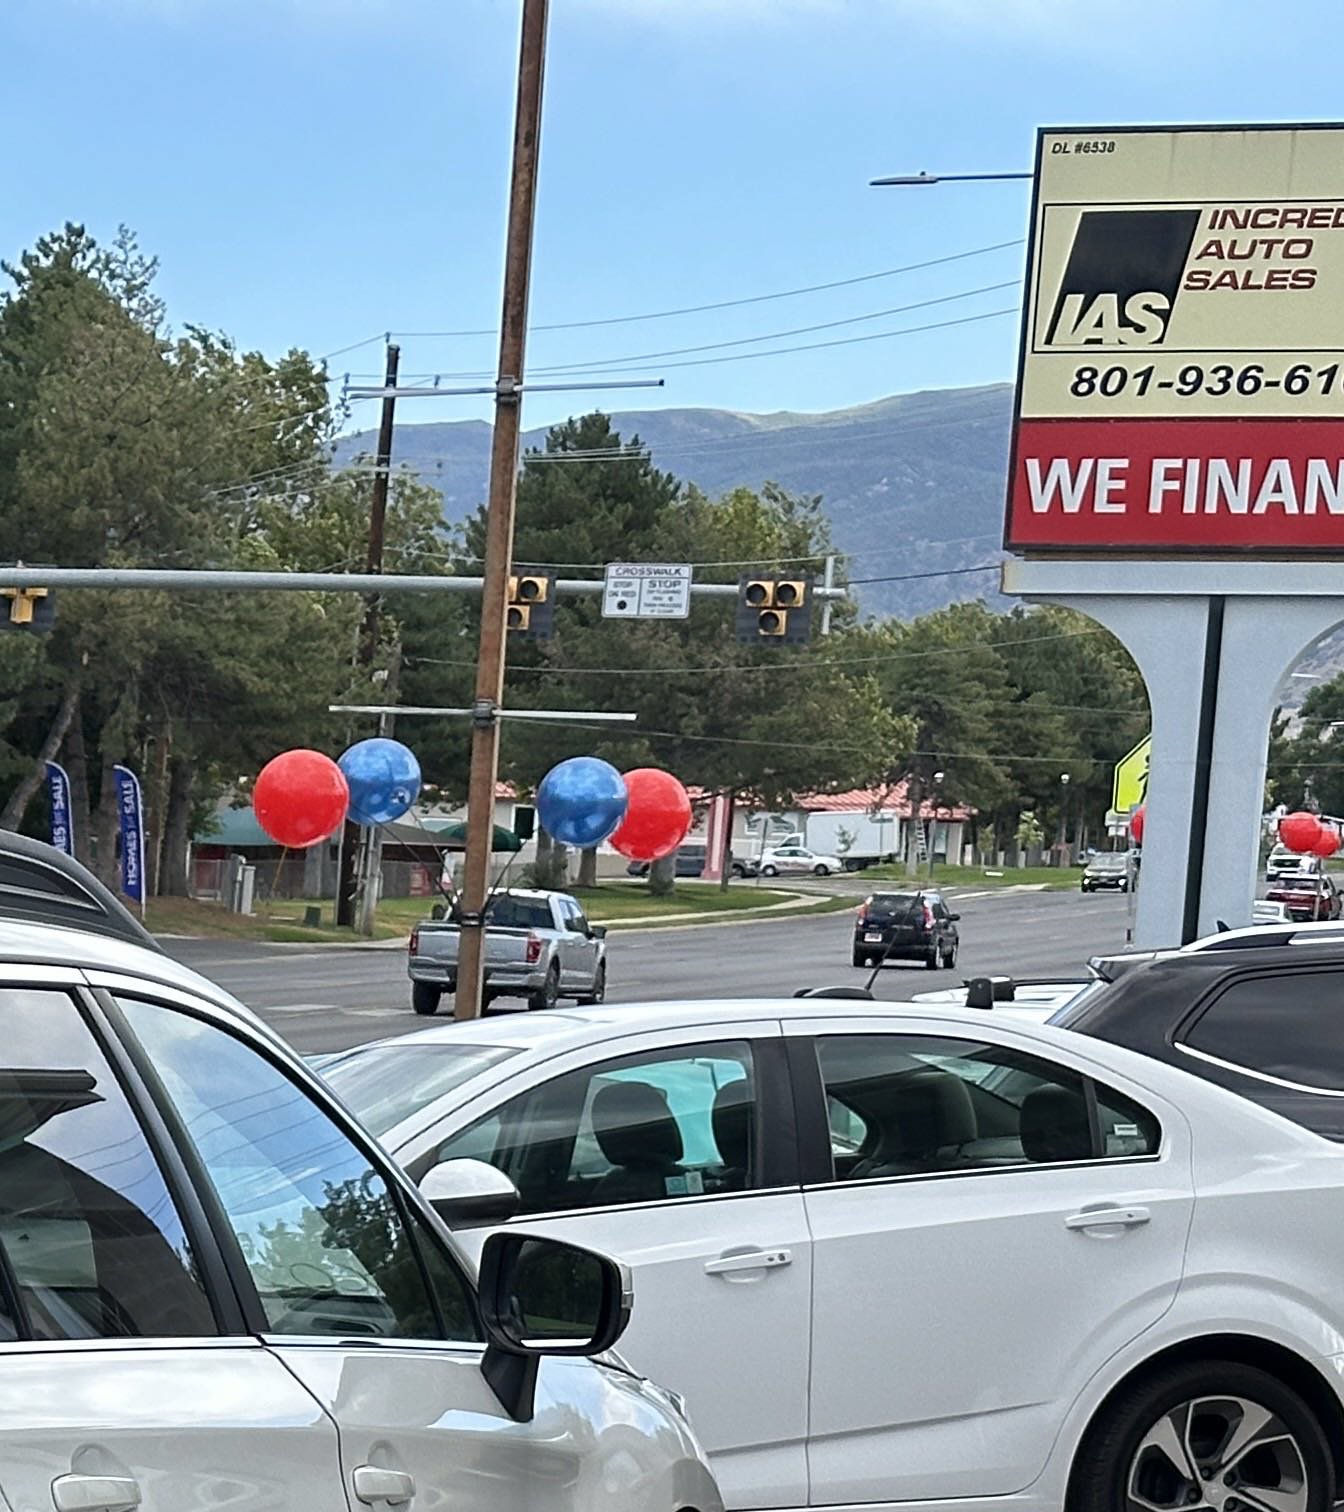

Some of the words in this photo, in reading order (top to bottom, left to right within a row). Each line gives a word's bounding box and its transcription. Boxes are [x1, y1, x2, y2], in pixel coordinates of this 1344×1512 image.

[1051, 142, 1070, 154] DL
[1195, 239, 1314, 260] AUTO
[1183, 269, 1317, 290] SALES
[1051, 291, 1170, 345] IAS
[1070, 363, 1344, 397] 801-936-61
[1025, 458, 1129, 514] WE
[1149, 457, 1344, 514] FINAN
[615, 567, 682, 576] CROSSWALK
[648, 580, 682, 588] STOP
